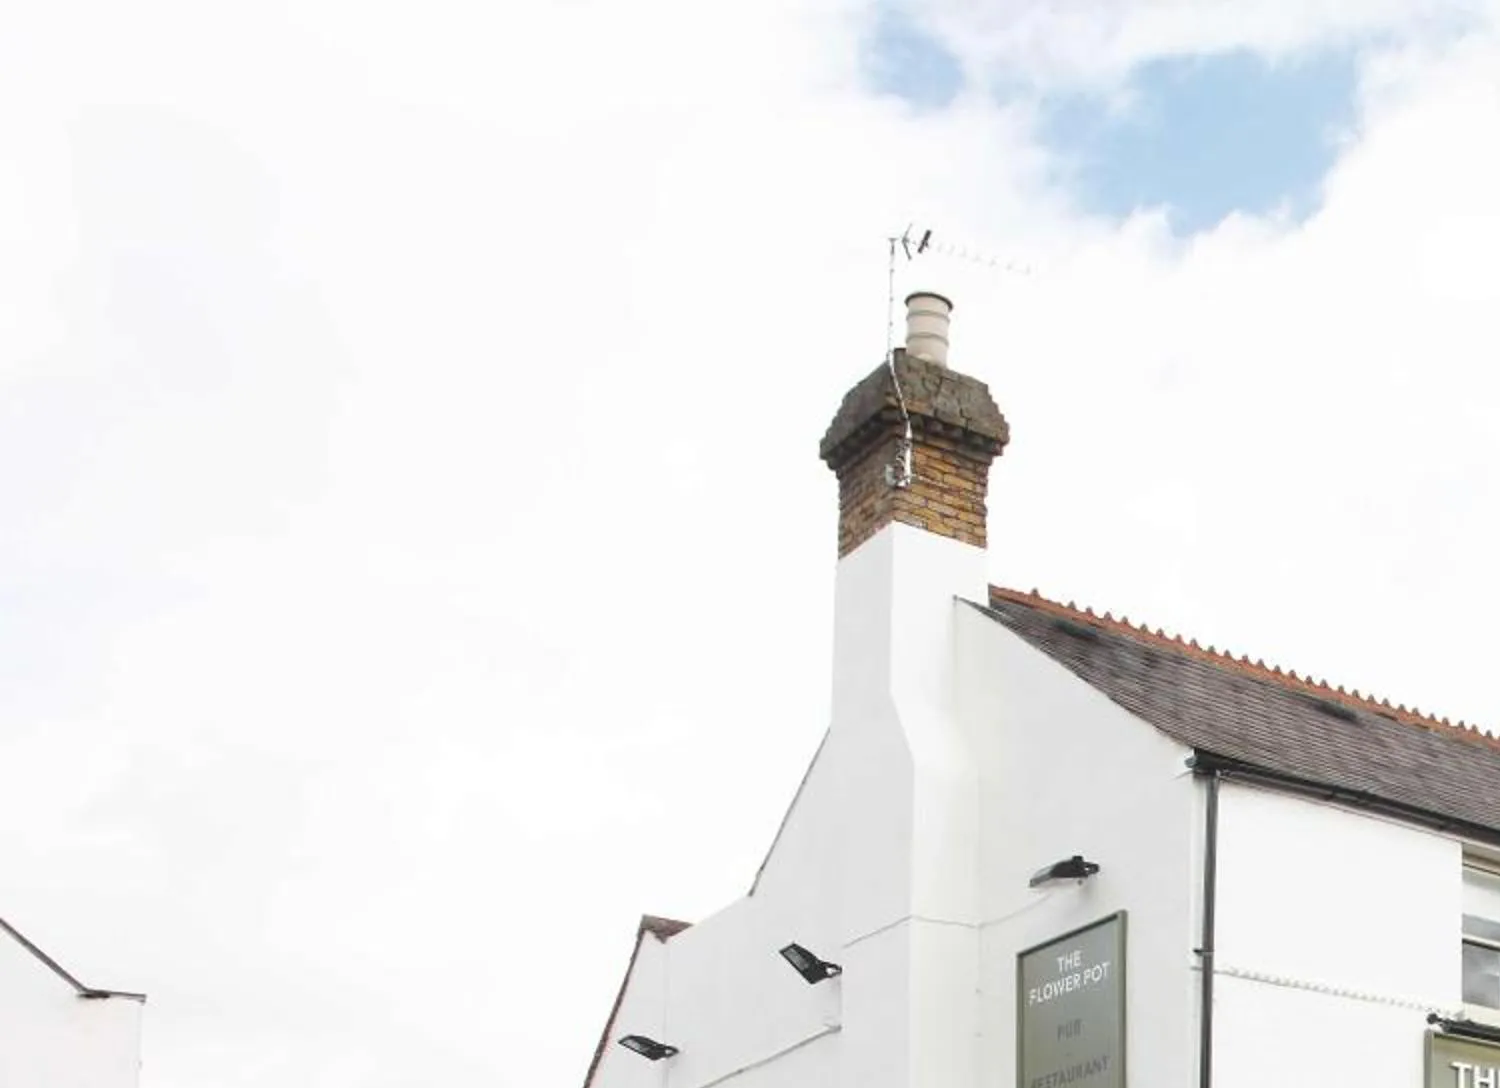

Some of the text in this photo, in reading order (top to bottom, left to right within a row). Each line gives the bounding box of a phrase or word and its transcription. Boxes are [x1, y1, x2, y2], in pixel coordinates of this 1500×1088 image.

[1057, 950, 1082, 973] THE
[1028, 961, 1110, 1007] FLOWER POT
[1057, 1018, 1083, 1042] PUB
